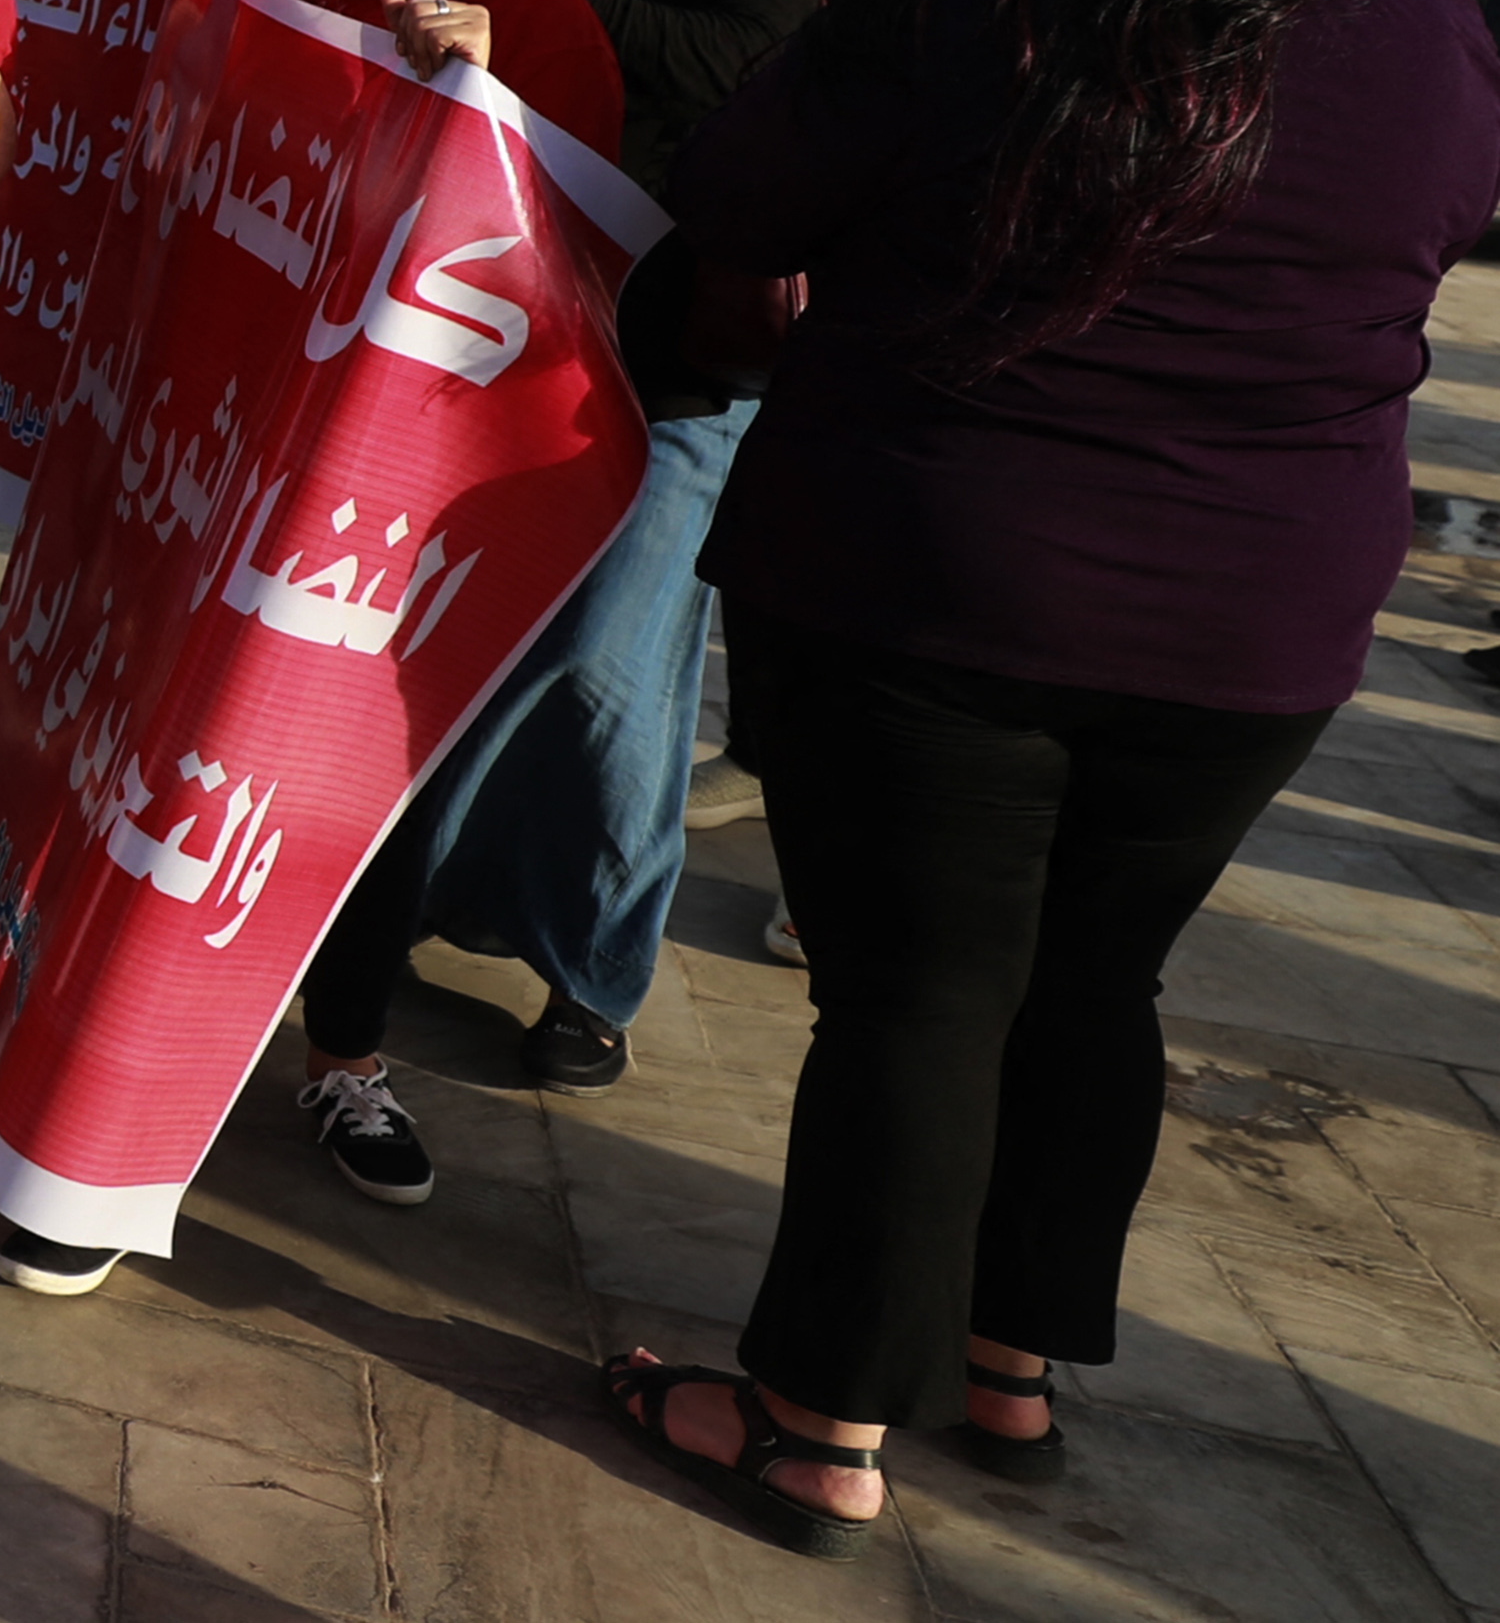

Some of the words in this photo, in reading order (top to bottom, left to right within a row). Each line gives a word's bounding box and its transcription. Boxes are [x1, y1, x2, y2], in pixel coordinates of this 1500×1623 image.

[304, 193, 531, 389] كل
[114, 374, 250, 549] الثوري
[34, 585, 113, 753] في
